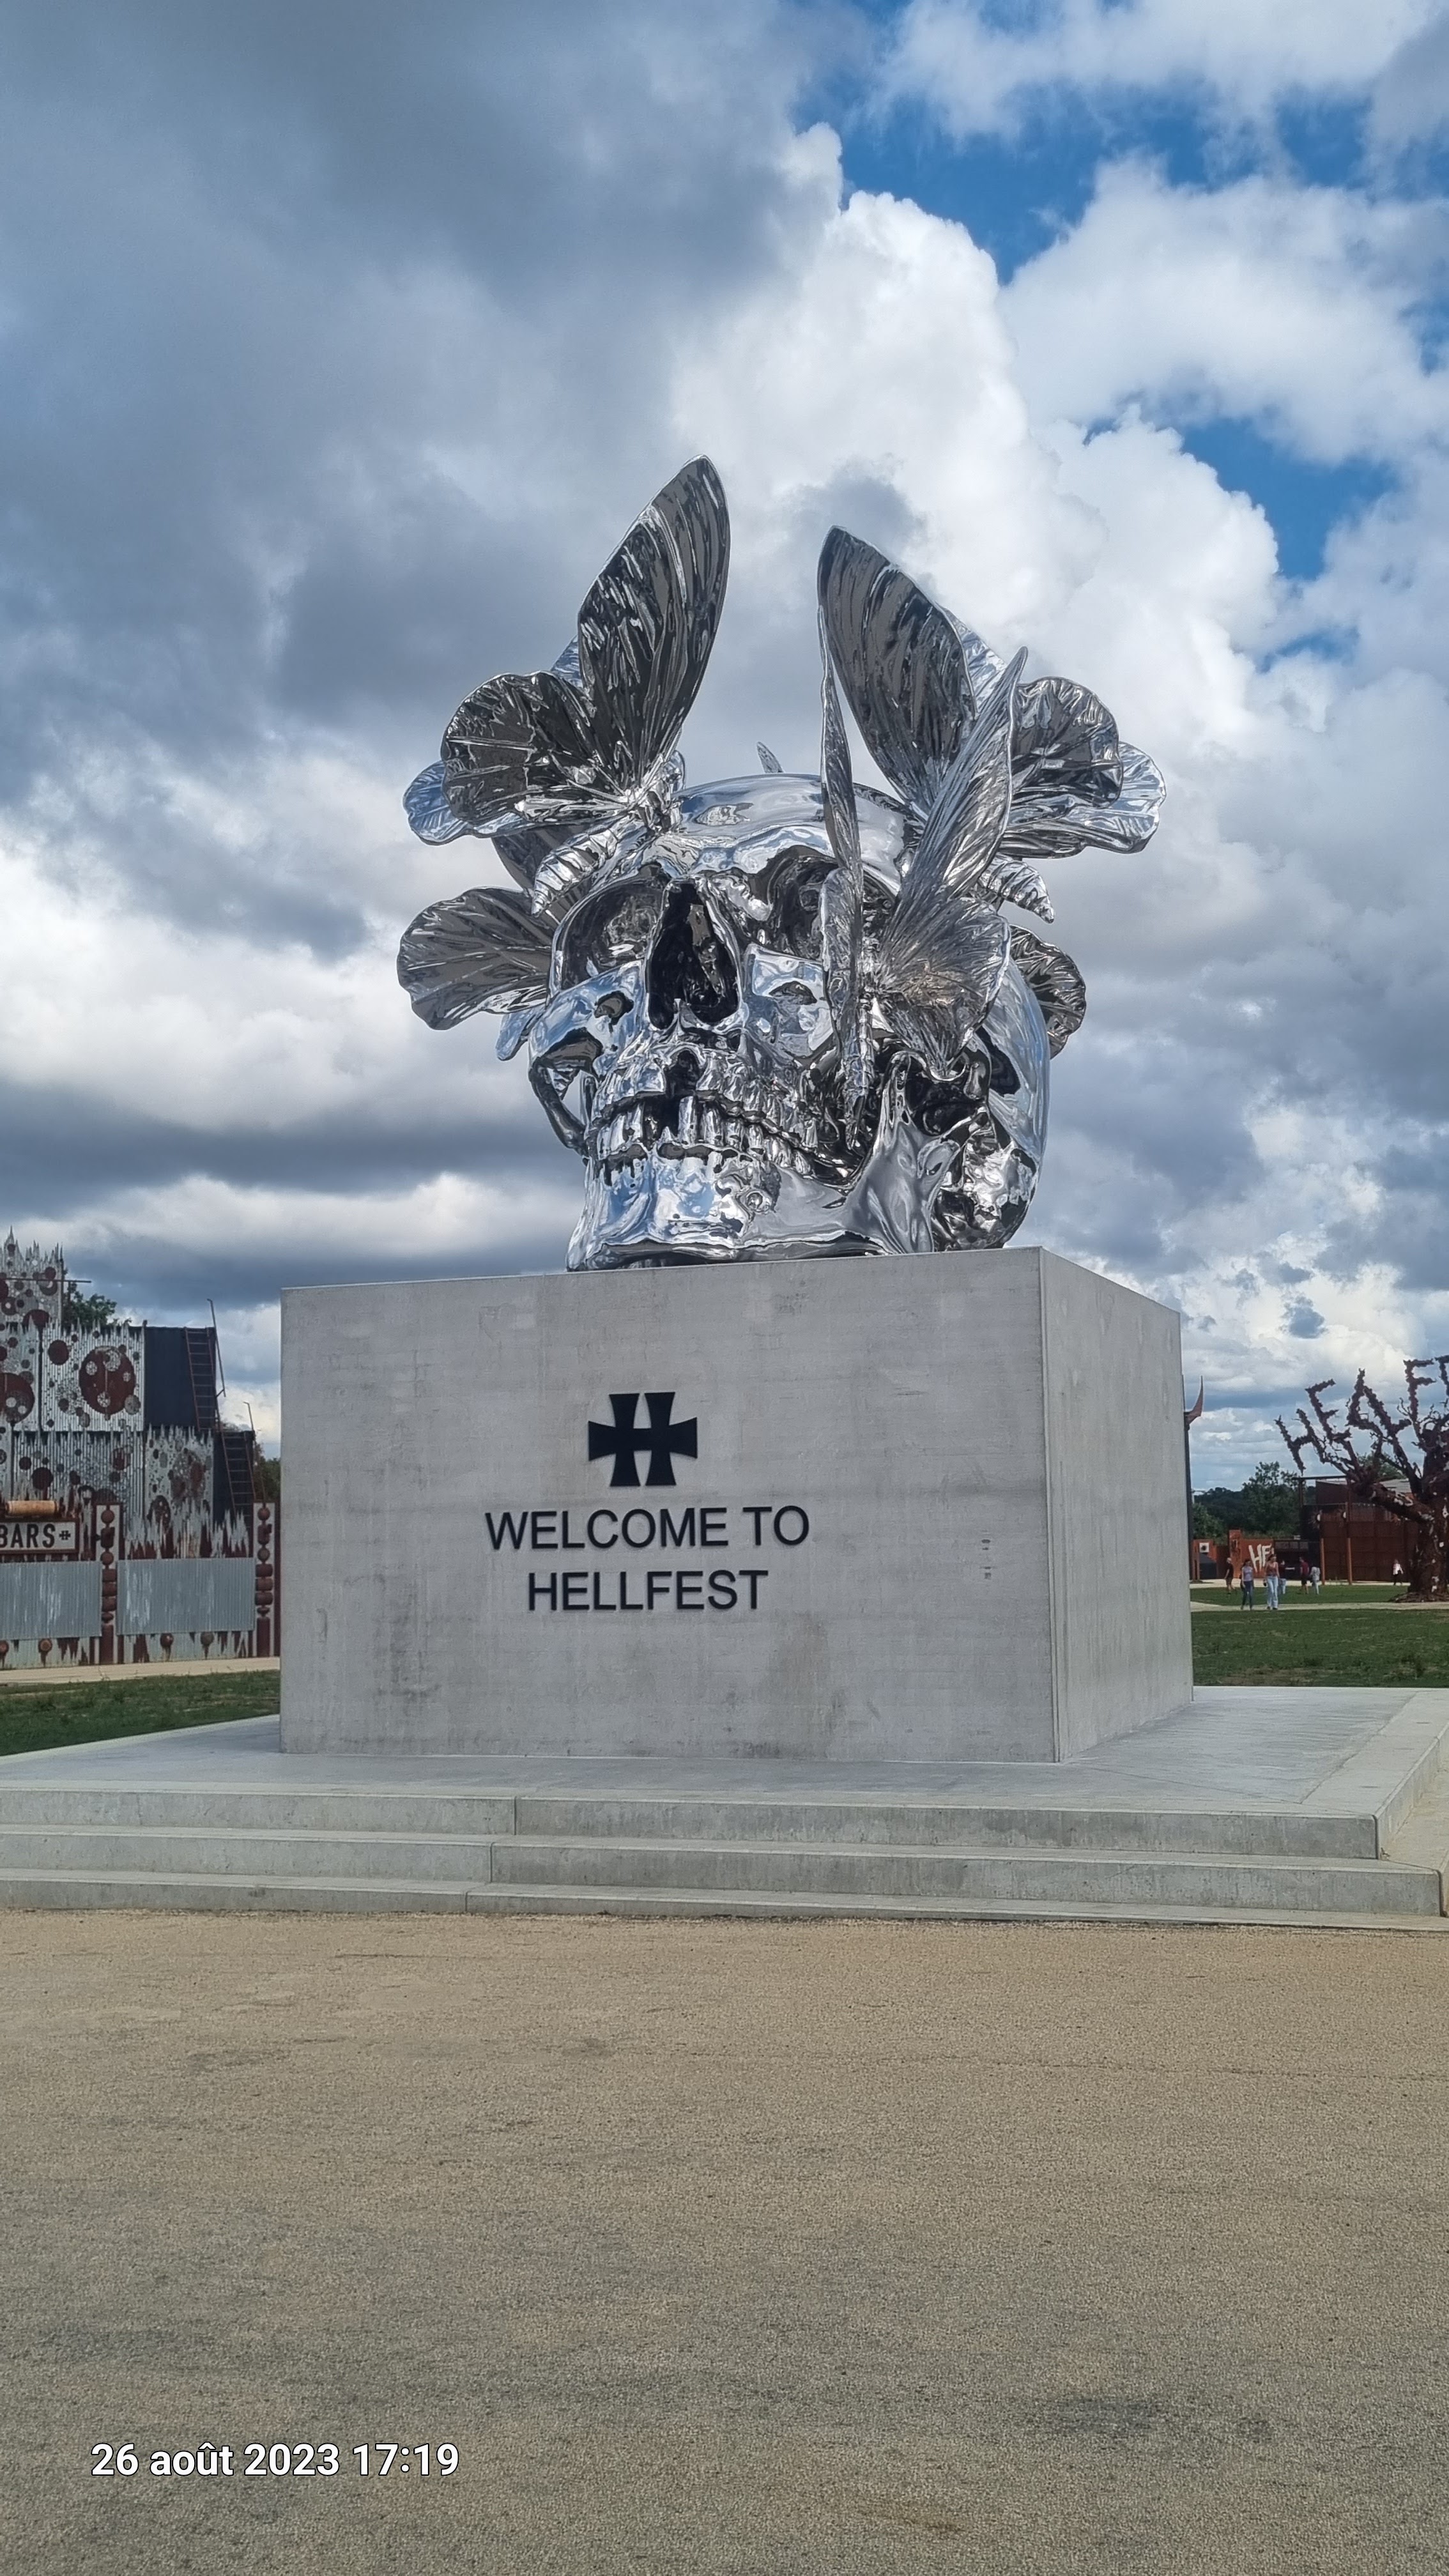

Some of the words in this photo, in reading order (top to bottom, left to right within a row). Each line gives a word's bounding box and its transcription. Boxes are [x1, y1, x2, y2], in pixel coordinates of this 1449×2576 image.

[484, 1507, 730, 1551] WELCOME
[742, 1505, 810, 1546] TO
[528, 1570, 769, 1611] HELLFEST
